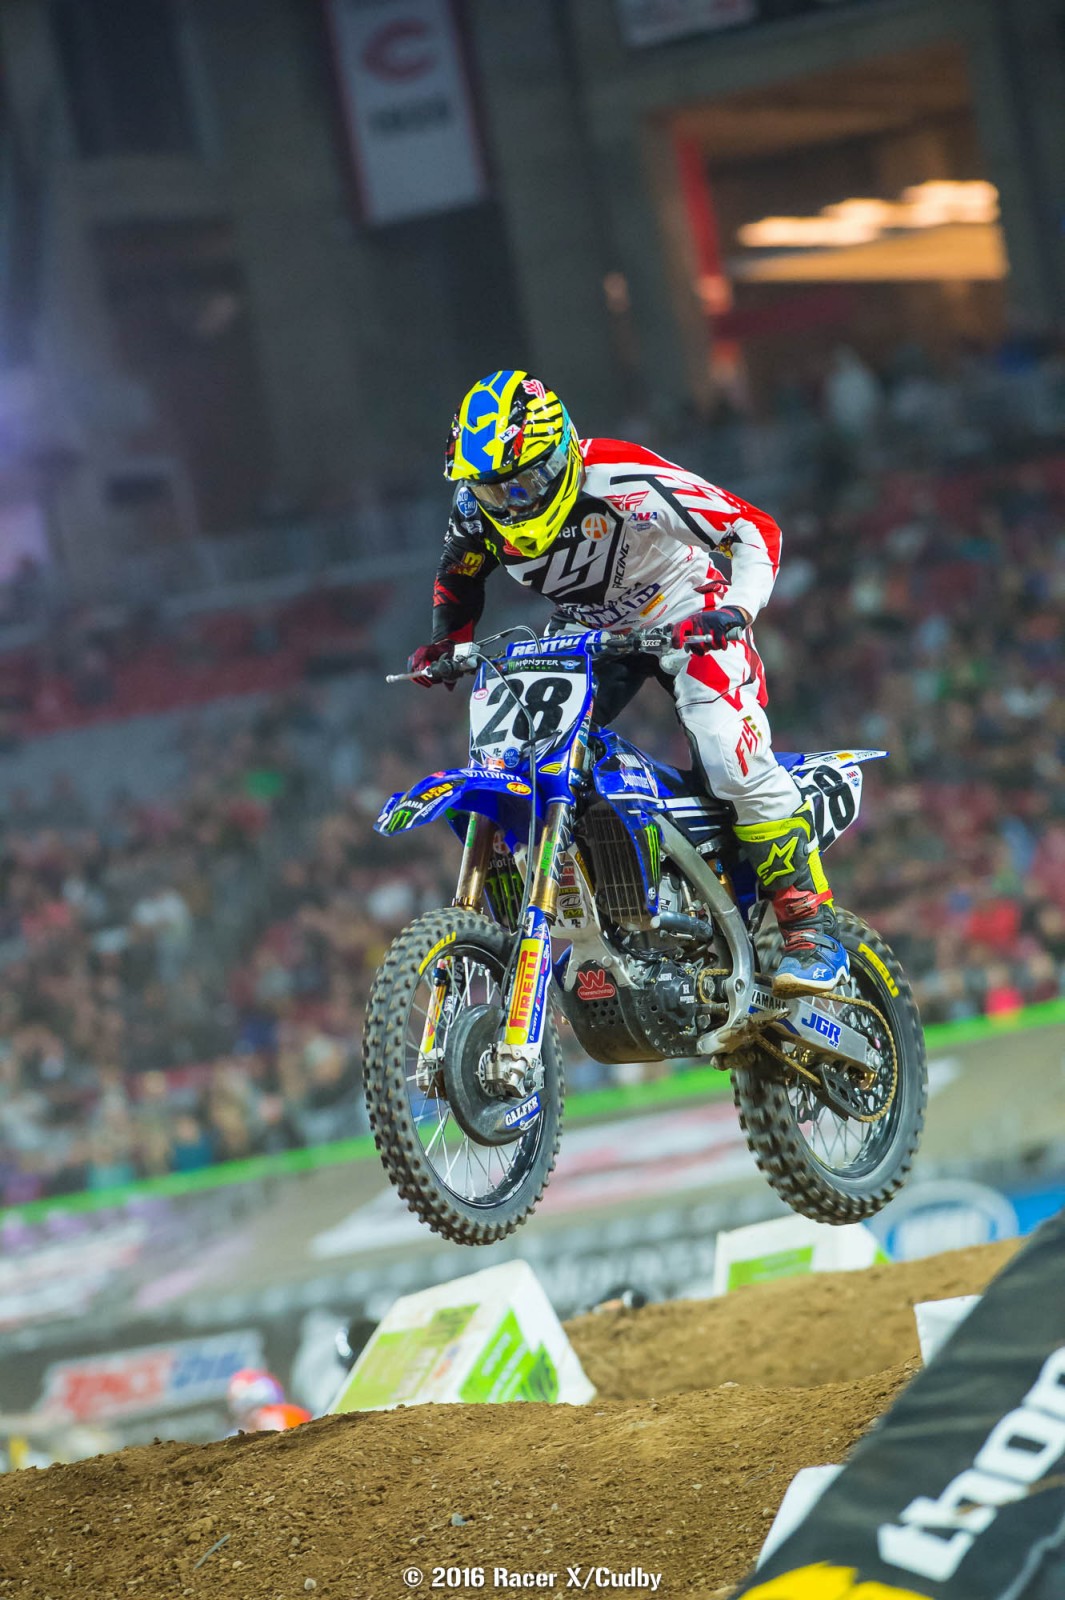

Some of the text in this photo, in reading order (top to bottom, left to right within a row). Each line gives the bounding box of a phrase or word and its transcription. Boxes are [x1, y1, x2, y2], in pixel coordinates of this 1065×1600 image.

[557, 525, 578, 539] er
[627, 512, 658, 522] AMA
[612, 542, 630, 589] RACING
[511, 635, 582, 657] RENTH
[515, 659, 559, 668] MONSTER
[475, 676, 573, 747] 28
[509, 950, 540, 1028] PIRELLI
[801, 1013, 842, 1043] JGR
[504, 1096, 539, 1127] GALFER
